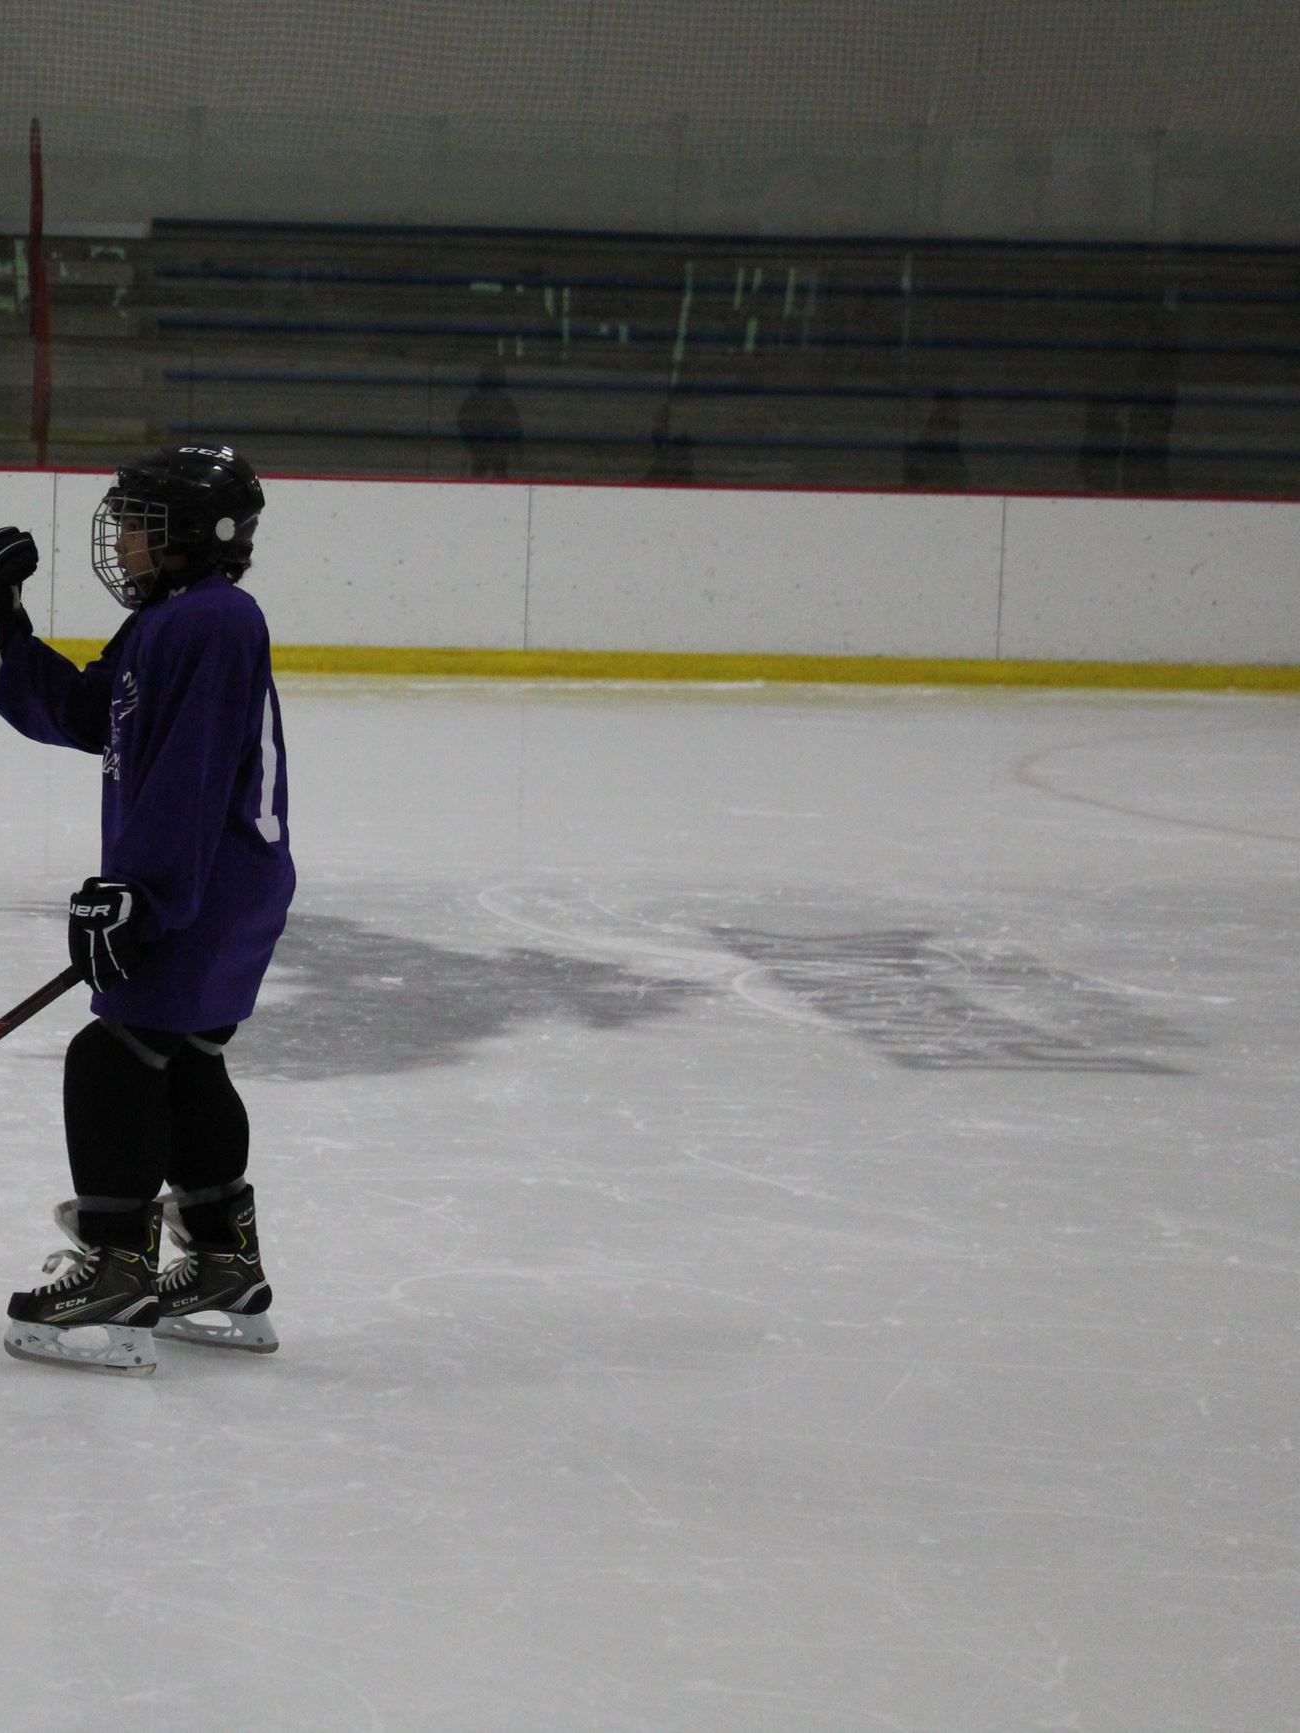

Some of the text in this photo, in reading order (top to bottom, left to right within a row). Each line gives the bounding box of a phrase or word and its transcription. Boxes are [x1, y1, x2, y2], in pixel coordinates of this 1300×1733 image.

[178, 447, 234, 462] CCM
[55, 1297, 88, 1310] CCM
[172, 1296, 199, 1308] CCM
